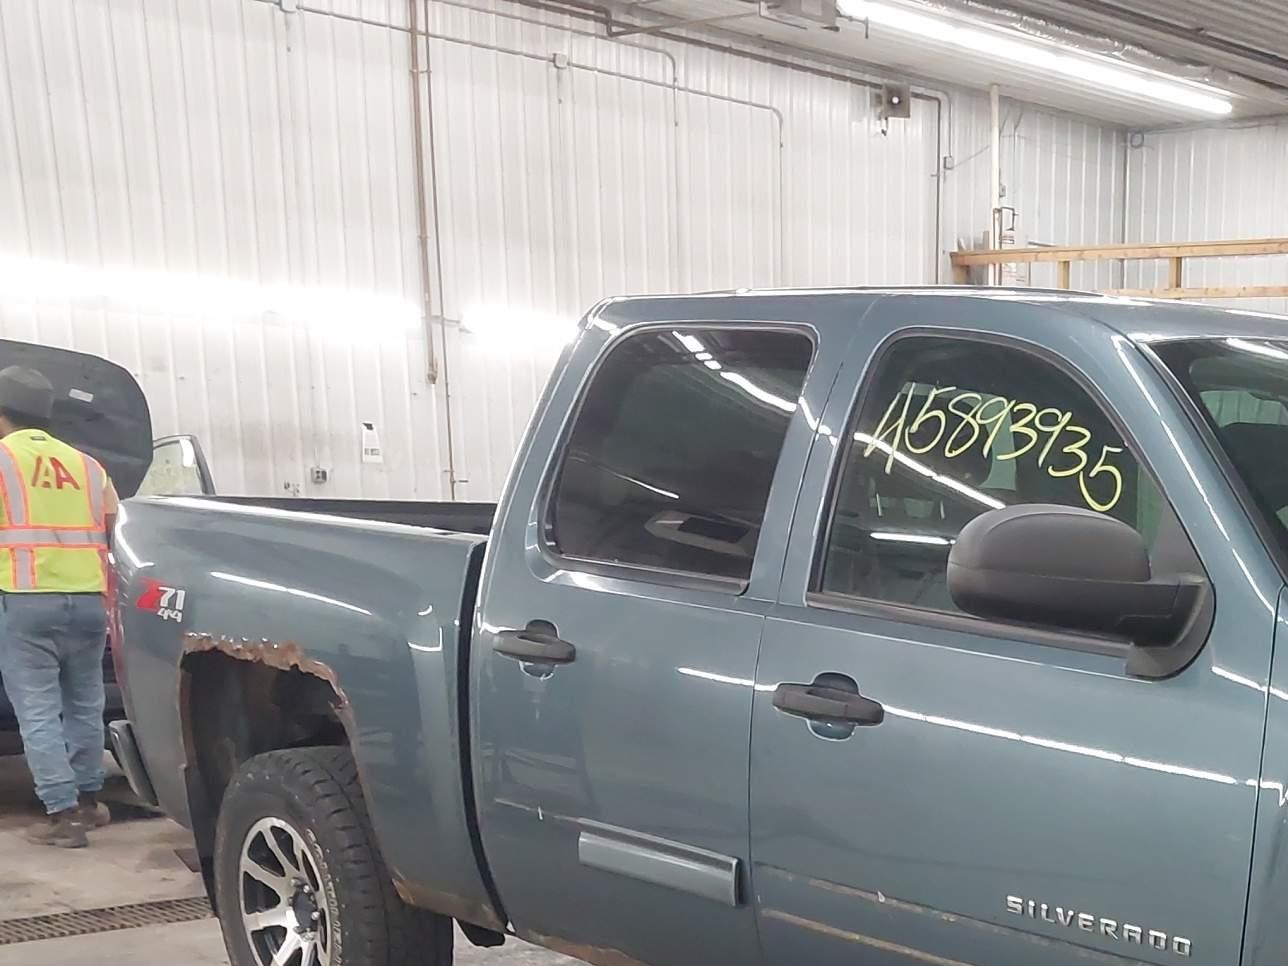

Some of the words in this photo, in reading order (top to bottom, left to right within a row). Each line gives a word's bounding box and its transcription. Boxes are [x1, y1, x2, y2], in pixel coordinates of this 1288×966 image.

[863, 381, 1128, 513] 45893935
[135, 576, 186, 611] Z71
[1005, 895, 1193, 958] SILVERADO
